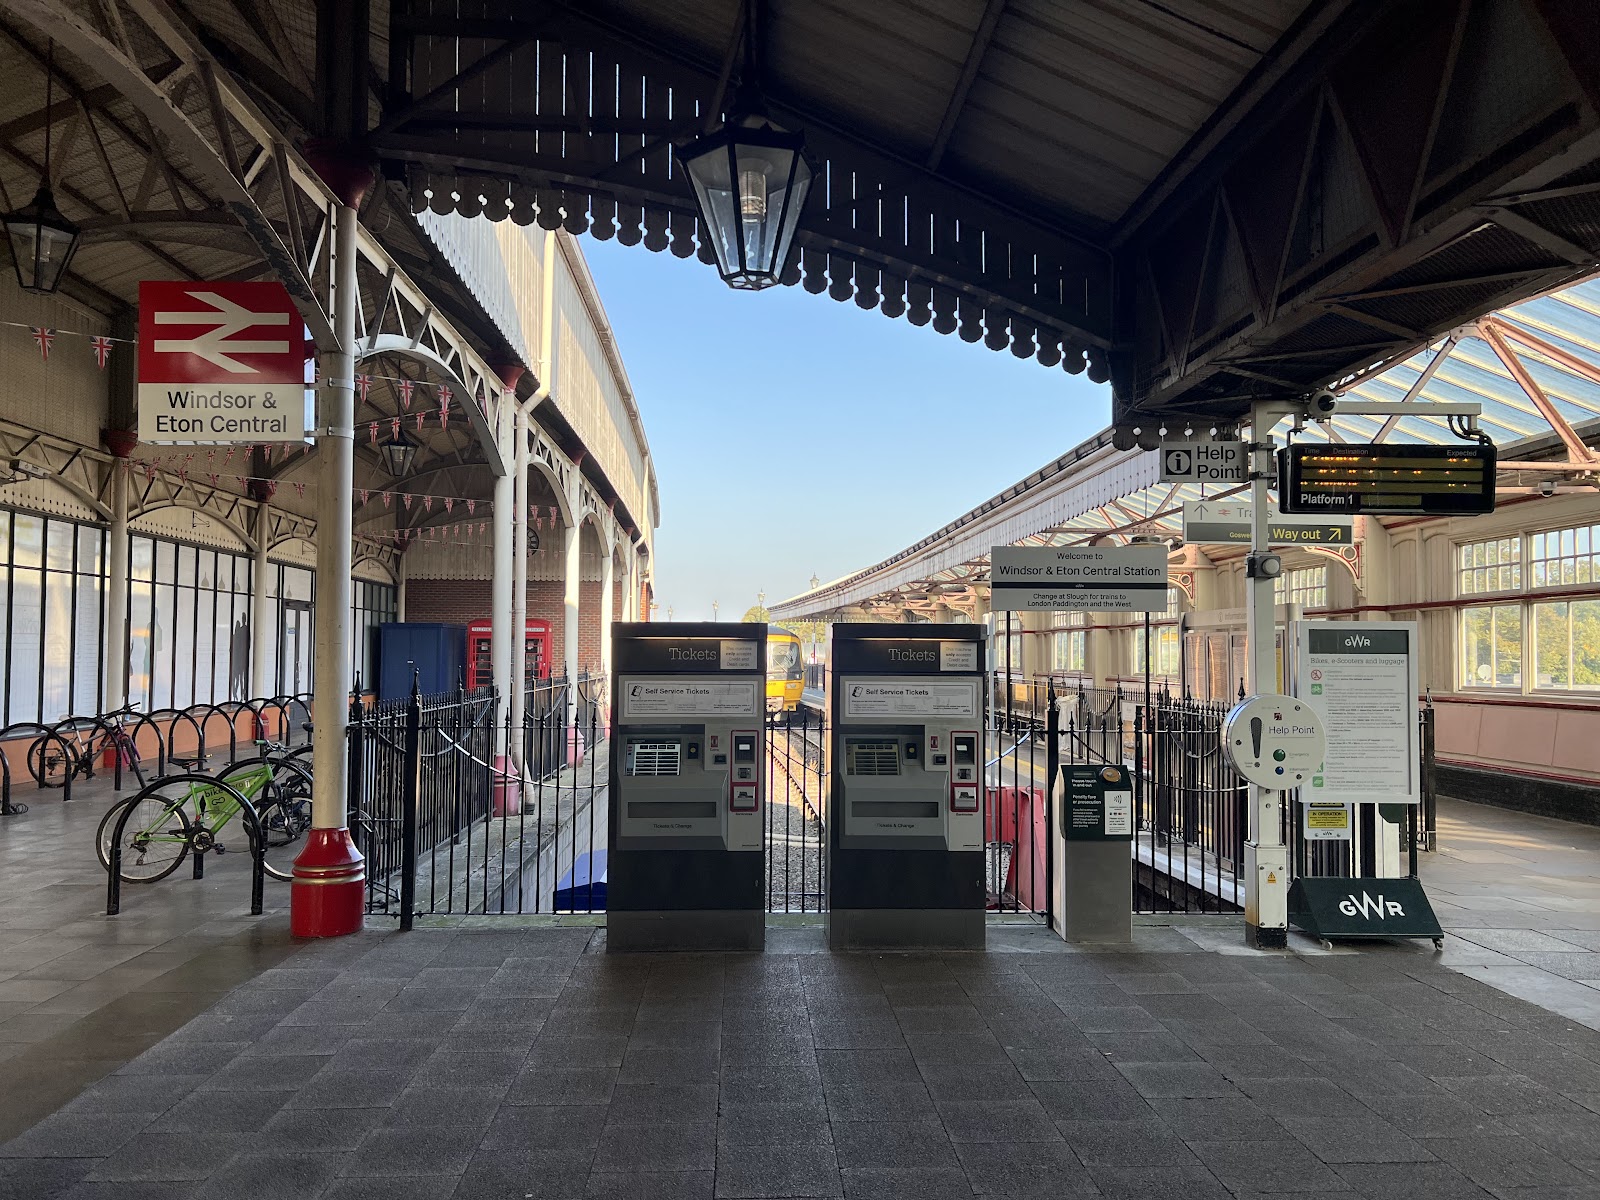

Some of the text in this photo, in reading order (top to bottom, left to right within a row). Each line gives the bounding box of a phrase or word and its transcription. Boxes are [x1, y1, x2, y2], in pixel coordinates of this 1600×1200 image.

[168, 391, 277, 409] Windsor &
[156, 415, 287, 433] Eton Central
[1197, 446, 1236, 466] Help
[1197, 465, 1241, 479] Point
[1300, 494, 1353, 504] Platform 1
[1273, 528, 1321, 542] Way out
[1000, 566, 1161, 576] Windsor & Eton Central Station
[1344, 634, 1371, 648] GWR
[668, 648, 717, 660] Tickets
[888, 648, 936, 661] Tickets
[1268, 726, 1314, 735] Help Point
[1338, 890, 1406, 920] GWR
